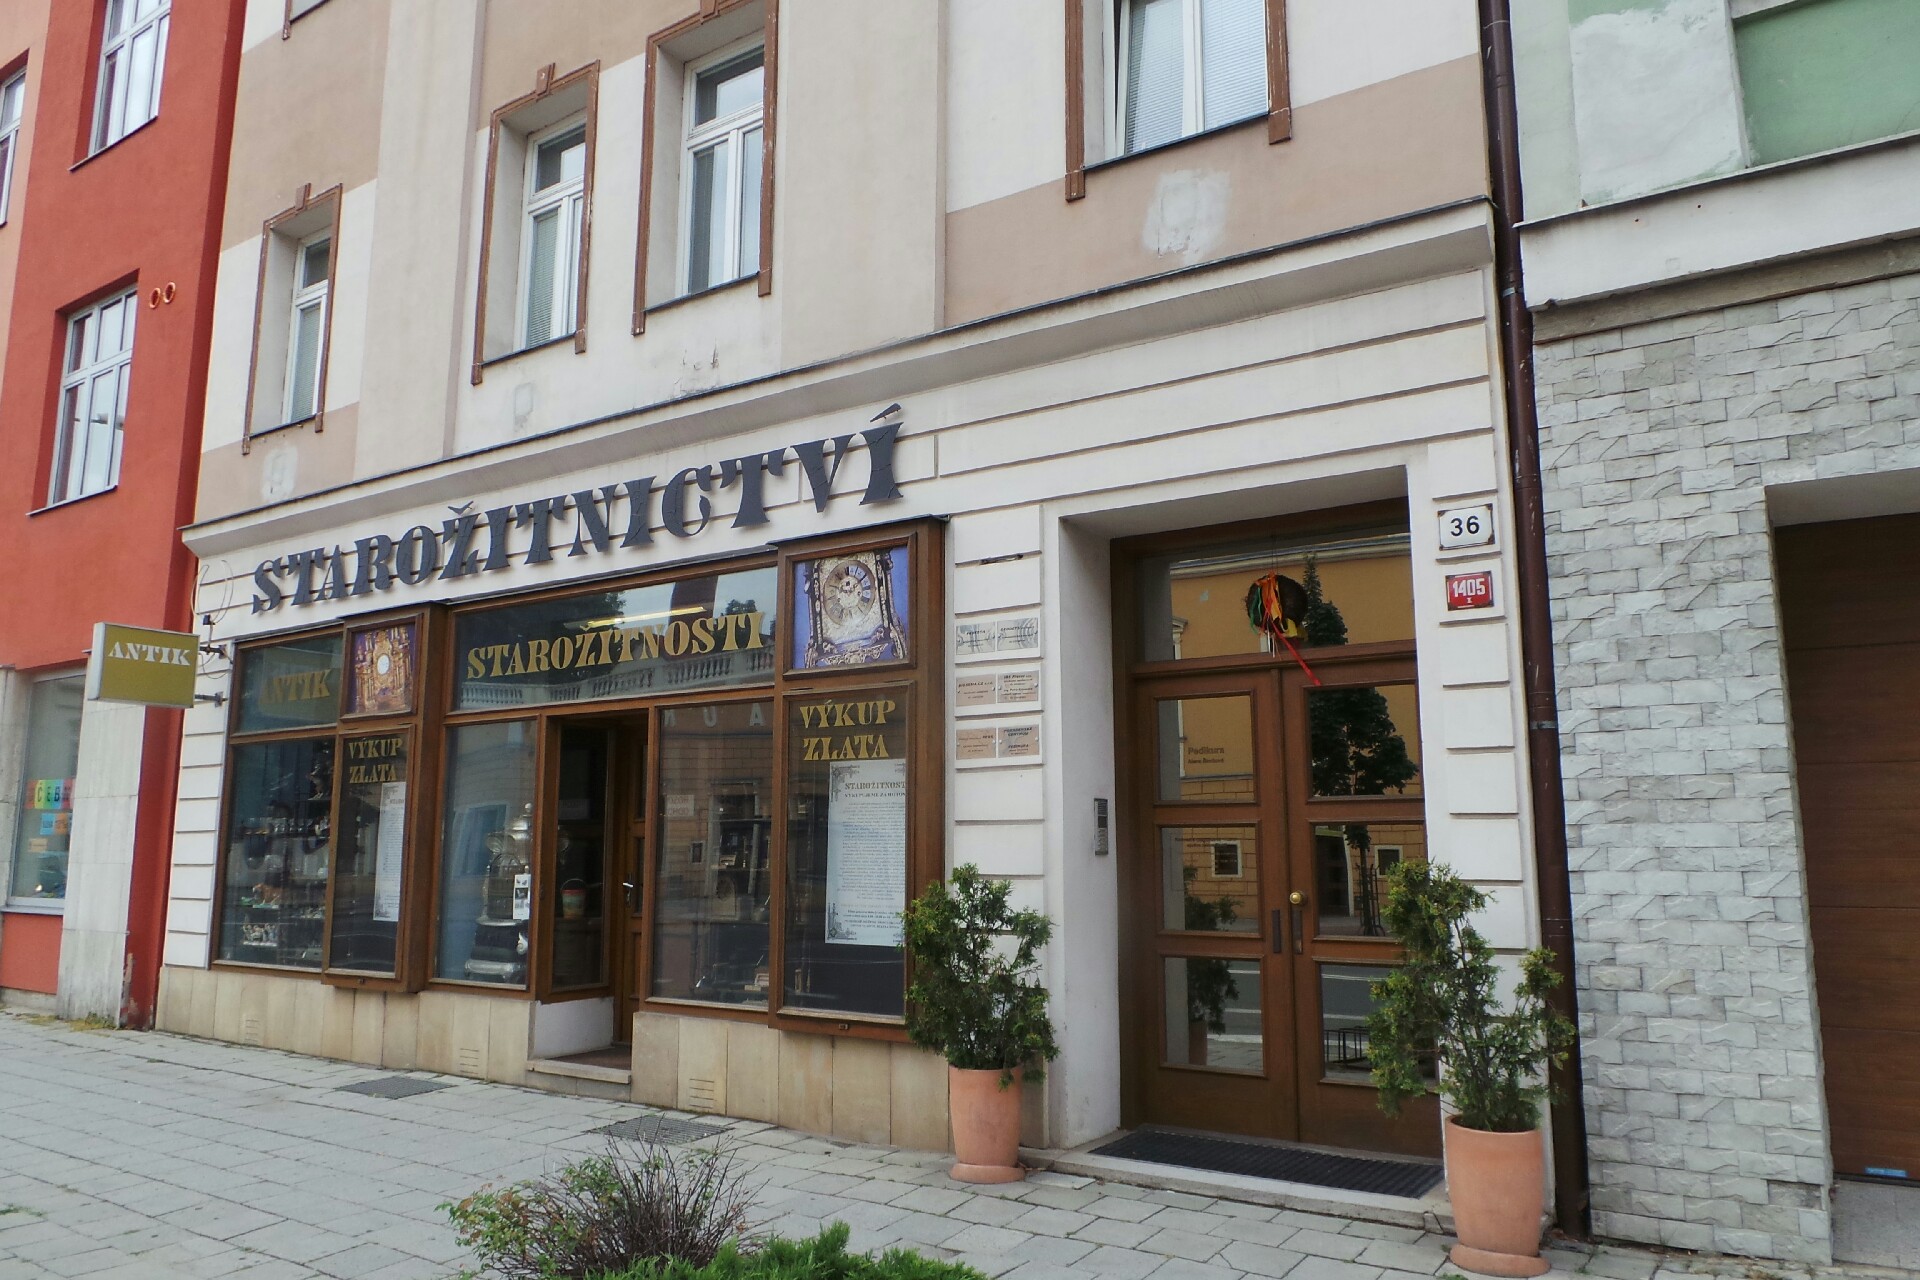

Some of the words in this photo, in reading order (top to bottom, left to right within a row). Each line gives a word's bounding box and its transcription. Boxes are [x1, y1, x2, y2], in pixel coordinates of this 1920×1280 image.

[251, 403, 905, 615] STAROŽITNICTVÍ
[1450, 515, 1480, 537] 36
[1453, 578, 1486, 598] 1405
[108, 641, 190, 666] ANTIK
[467, 611, 766, 680] STAROŽITNOSTI
[259, 669, 331, 704] ANTIK
[799, 699, 896, 729] VÝKUP
[348, 737, 402, 759] VÝKUP
[803, 734, 889, 761] ZLATA
[349, 763, 397, 784] ZLATA
